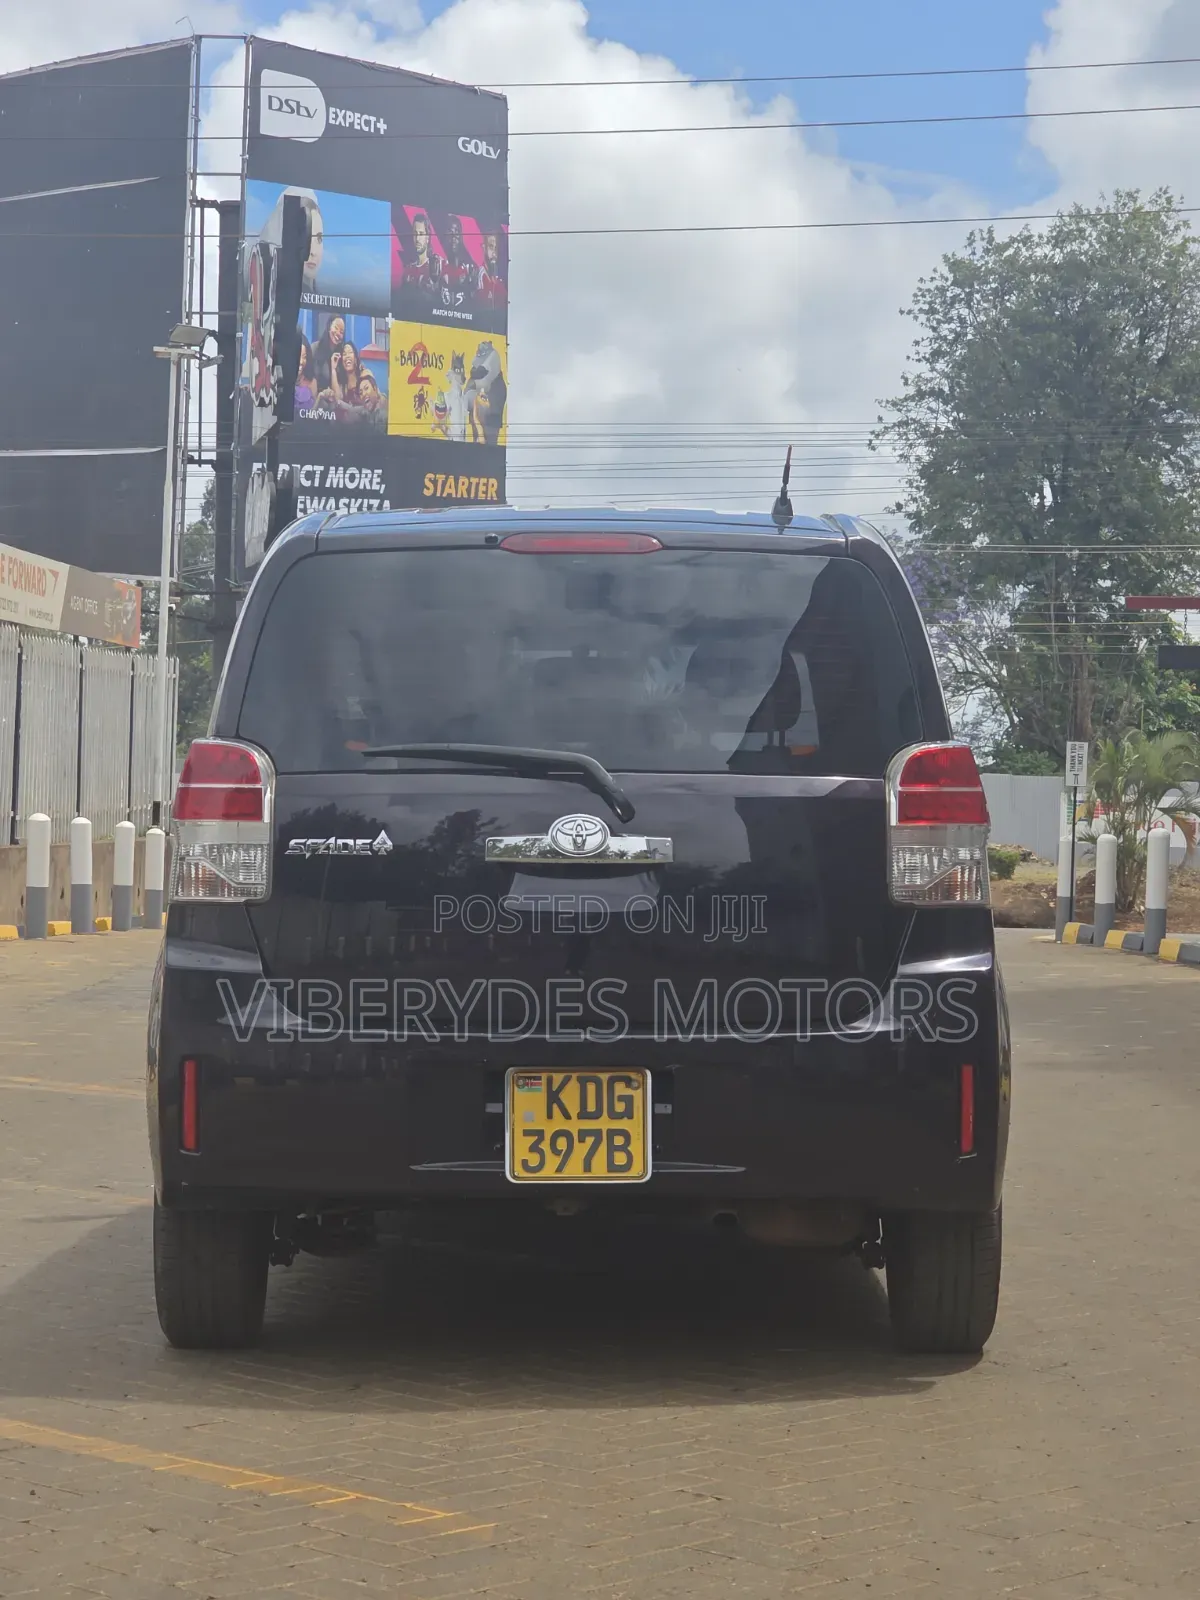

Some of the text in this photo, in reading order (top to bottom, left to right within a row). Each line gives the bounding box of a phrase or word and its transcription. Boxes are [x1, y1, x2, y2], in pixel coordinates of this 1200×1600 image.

[268, 95, 318, 119] DStv
[457, 136, 501, 159] GOtv
[303, 292, 328, 306] SECRET
[328, 295, 351, 308] TRUTH
[432, 308, 473, 320] MATCH OF THE WEEK
[400, 349, 445, 371] BAD GUYS
[407, 341, 432, 386] 2
[251, 462, 386, 494] EPCT MORE,
[423, 472, 498, 501] STARTER
[8, 555, 47, 598] FORWARD
[1069, 755, 1077, 773] THANK
[285, 836, 373, 860] SPADE
[546, 1074, 635, 1121] KDG
[521, 1128, 634, 1175] 397B
